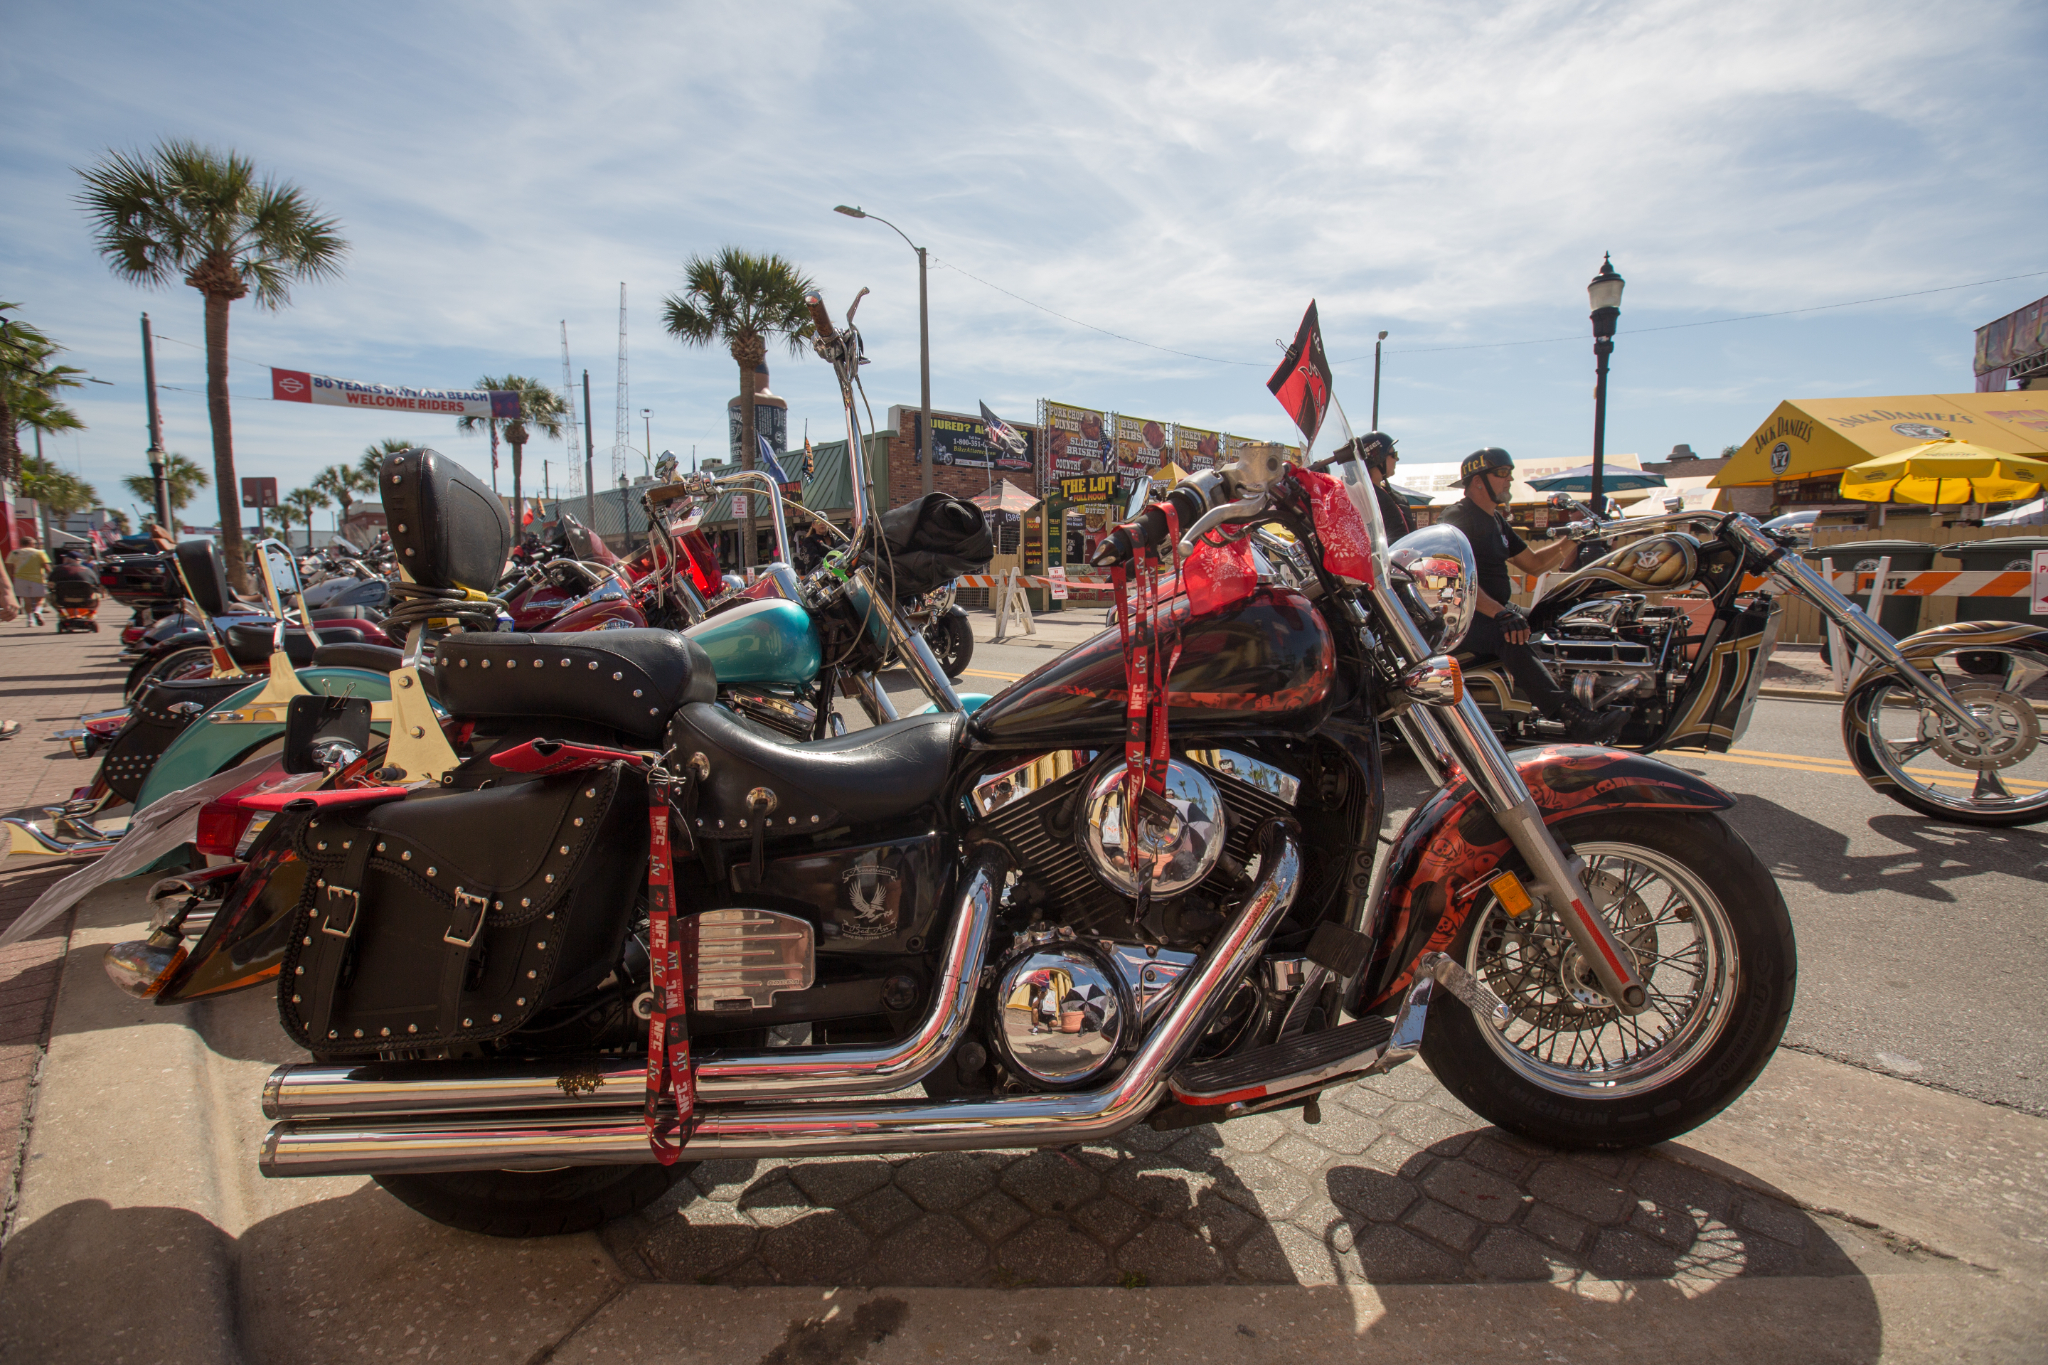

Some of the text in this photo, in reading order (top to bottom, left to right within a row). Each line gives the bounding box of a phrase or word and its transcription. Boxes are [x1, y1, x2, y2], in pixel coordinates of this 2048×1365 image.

[313, 377, 333, 389] 80
[334, 380, 381, 394] YEARS
[447, 391, 488, 402] BEACH
[346, 392, 465, 412] WELCOME RIDERS
[1050, 406, 1084, 421] PORK CHOP
[1828, 410, 1976, 428] JACK DANIEL'S
[1054, 418, 1080, 432] DINNER
[1120, 419, 1140, 432] BBQ
[1070, 436, 1098, 448] SLICED
[1120, 430, 1142, 441] RIBS
[1180, 430, 1202, 440] URKEY
[1755, 416, 1814, 454] JACK DANIEL'S
[1066, 446, 1103, 458] BRISKET
[1138, 447, 1160, 457] BAKED
[1181, 440, 1198, 450] LEGS
[1056, 459, 1082, 470] COUNTRY
[1136, 455, 1160, 466] POTATO
[1193, 455, 1214, 464] SWEET
[1061, 478, 1086, 498] THE
[1090, 476, 1116, 494] LOT
[1074, 494, 1087, 502] FULL
[1088, 493, 1106, 501] MOON
[1130, 683, 1144, 710] NFC
[1150, 758, 1168, 784] LV
[655, 815, 666, 846] NFC
[847, 864, 892, 876] American
[655, 919, 667, 949] NFC
[667, 980, 678, 1009] NFC
[653, 1020, 665, 1052] NFC
[677, 1081, 690, 1114] NFC
